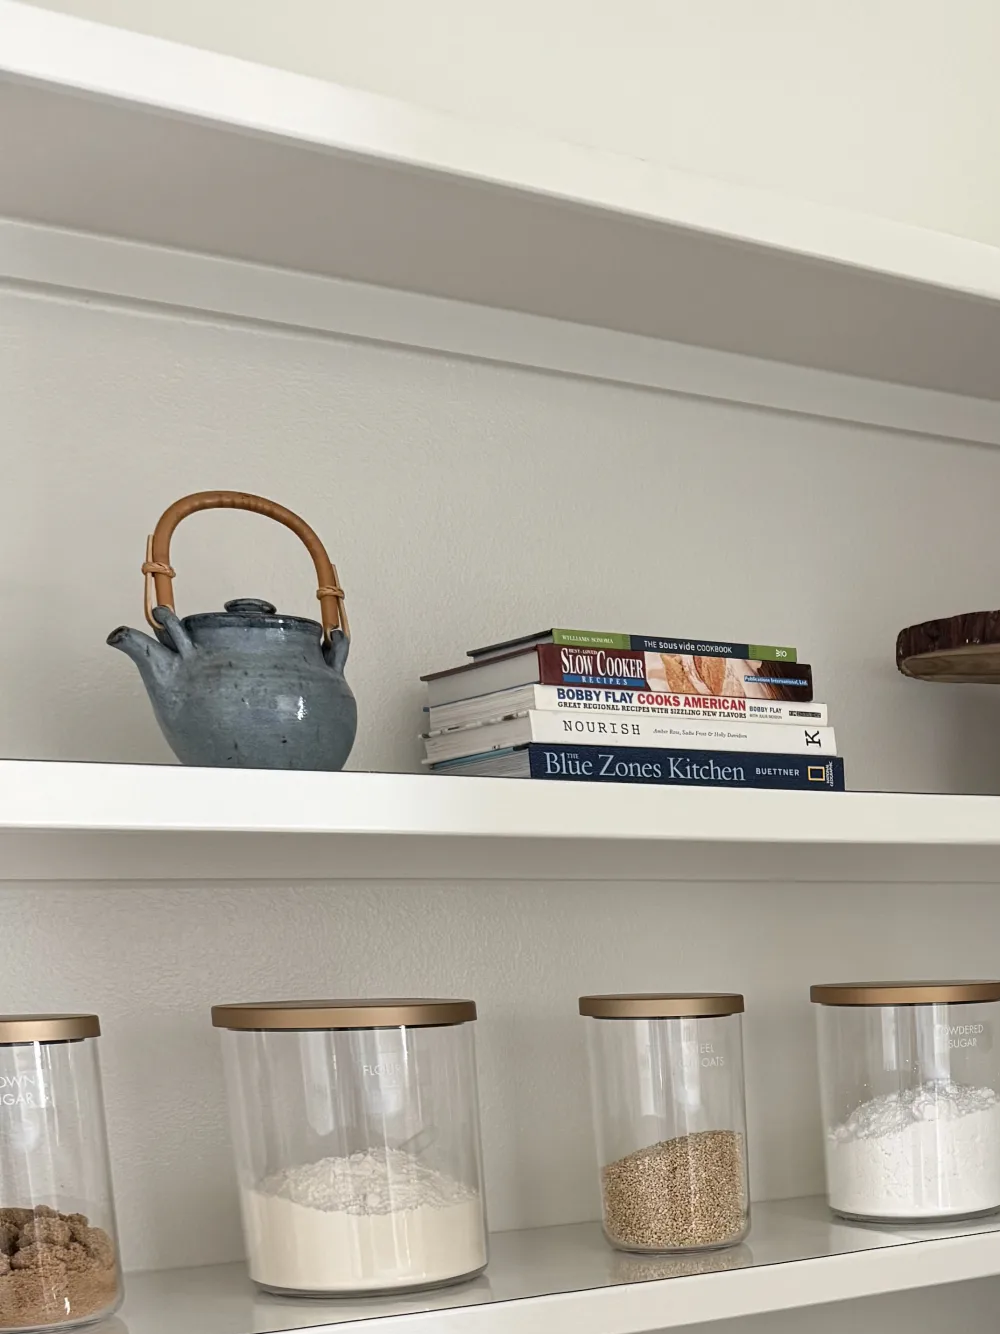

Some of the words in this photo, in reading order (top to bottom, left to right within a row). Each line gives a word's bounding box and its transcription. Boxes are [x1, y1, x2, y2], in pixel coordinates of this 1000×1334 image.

[644, 640, 657, 649] THE
[679, 640, 695, 652] vide
[697, 643, 733, 654] COOKBOOK
[560, 647, 594, 675] SLOW
[596, 650, 645, 679] COOKER
[581, 675, 628, 686] RECIPES
[557, 688, 601, 703] BOBBY
[604, 690, 634, 704] FLAY
[637, 693, 681, 707] COOKS
[683, 695, 746, 712] AMERICAN
[749, 705, 768, 713] BOBBY
[583, 703, 620, 712] REGIONAL
[621, 705, 650, 713] RECIPES
[651, 706, 668, 715] WITH
[670, 707, 701, 717] SIZZLING
[702, 710, 717, 718] NEW
[719, 710, 746, 719] FLAVORS
[562, 719, 641, 736] NOURISH
[804, 729, 822, 748] K
[566, 752, 579, 760] THE
[543, 751, 593, 776] Blue
[598, 753, 662, 778] Zones
[667, 757, 746, 781] Kitchen
[755, 767, 800, 777] BUETTNER
[947, 1037, 978, 1049] SUGAR
[362, 1063, 402, 1076] FLOUR
[701, 1056, 725, 1068] OATS
